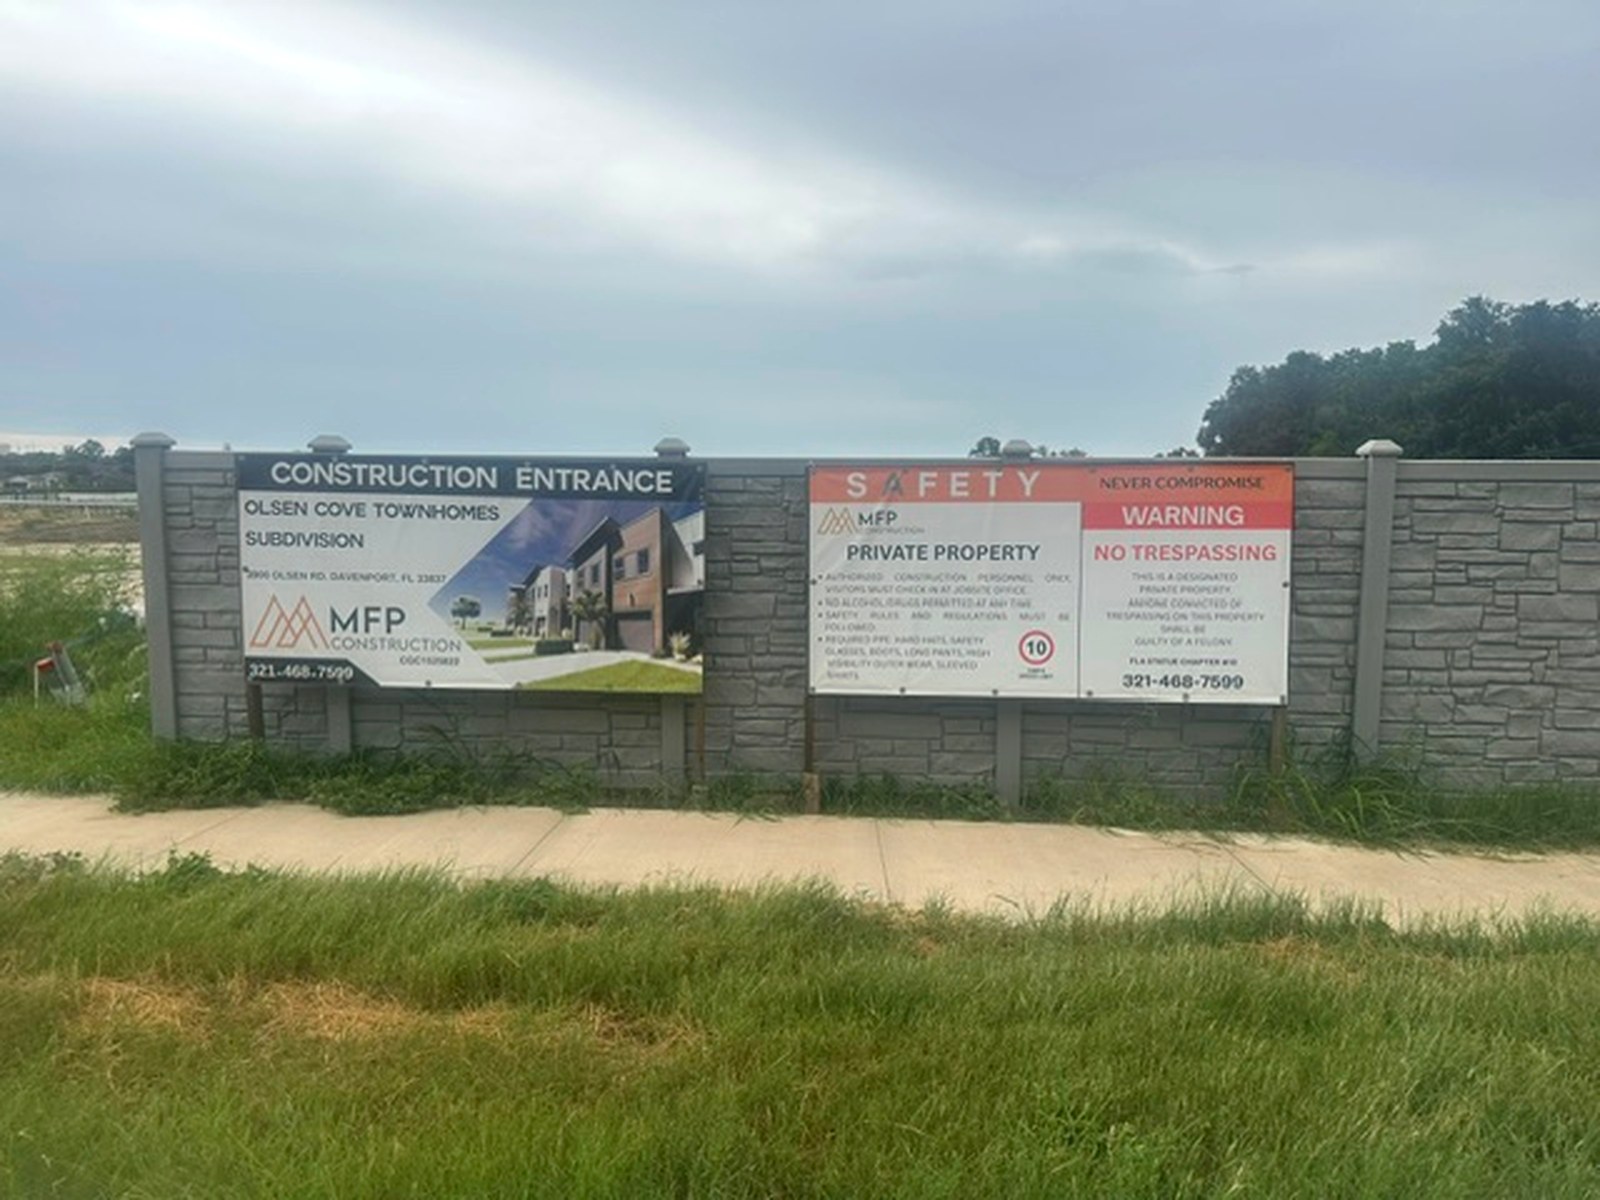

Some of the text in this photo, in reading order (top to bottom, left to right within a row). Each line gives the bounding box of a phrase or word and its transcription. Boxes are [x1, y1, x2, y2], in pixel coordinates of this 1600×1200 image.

[271, 461, 673, 493] CONSTRUCTION ENTRANCE
[847, 471, 1041, 498] SAFETY
[1101, 476, 1265, 490] NEVER COMPROMISE
[244, 499, 500, 521] OLSEN COVE TOWNHOMES
[858, 510, 898, 526] MFP
[1122, 505, 1246, 527] WARNING
[245, 530, 364, 549] SUBDIVISION
[847, 544, 1041, 561] PRIVATE PROPERTY
[1094, 544, 1277, 562] NO TRESPASSING
[272, 569, 308, 580] OLSEN
[401, 573, 414, 583] FL
[1131, 571, 1155, 581] THIS
[1176, 571, 1239, 582] DESIGNATED
[1139, 584, 1178, 594] PRIVATE
[1128, 597, 1243, 610] ANYONE CONVICTED OF
[330, 606, 406, 634] MFP
[825, 610, 859, 620] SAFETY
[1106, 611, 1171, 621] TRESPASSING
[1172, 611, 1188, 621] ON
[1214, 612, 1265, 623] PROPERTY
[331, 636, 462, 652] CONSTRUCTION
[1027, 640, 1048, 656] 10
[1134, 636, 1169, 647] GUILTY
[1170, 637, 1184, 647] OF
[1186, 637, 1194, 647] A
